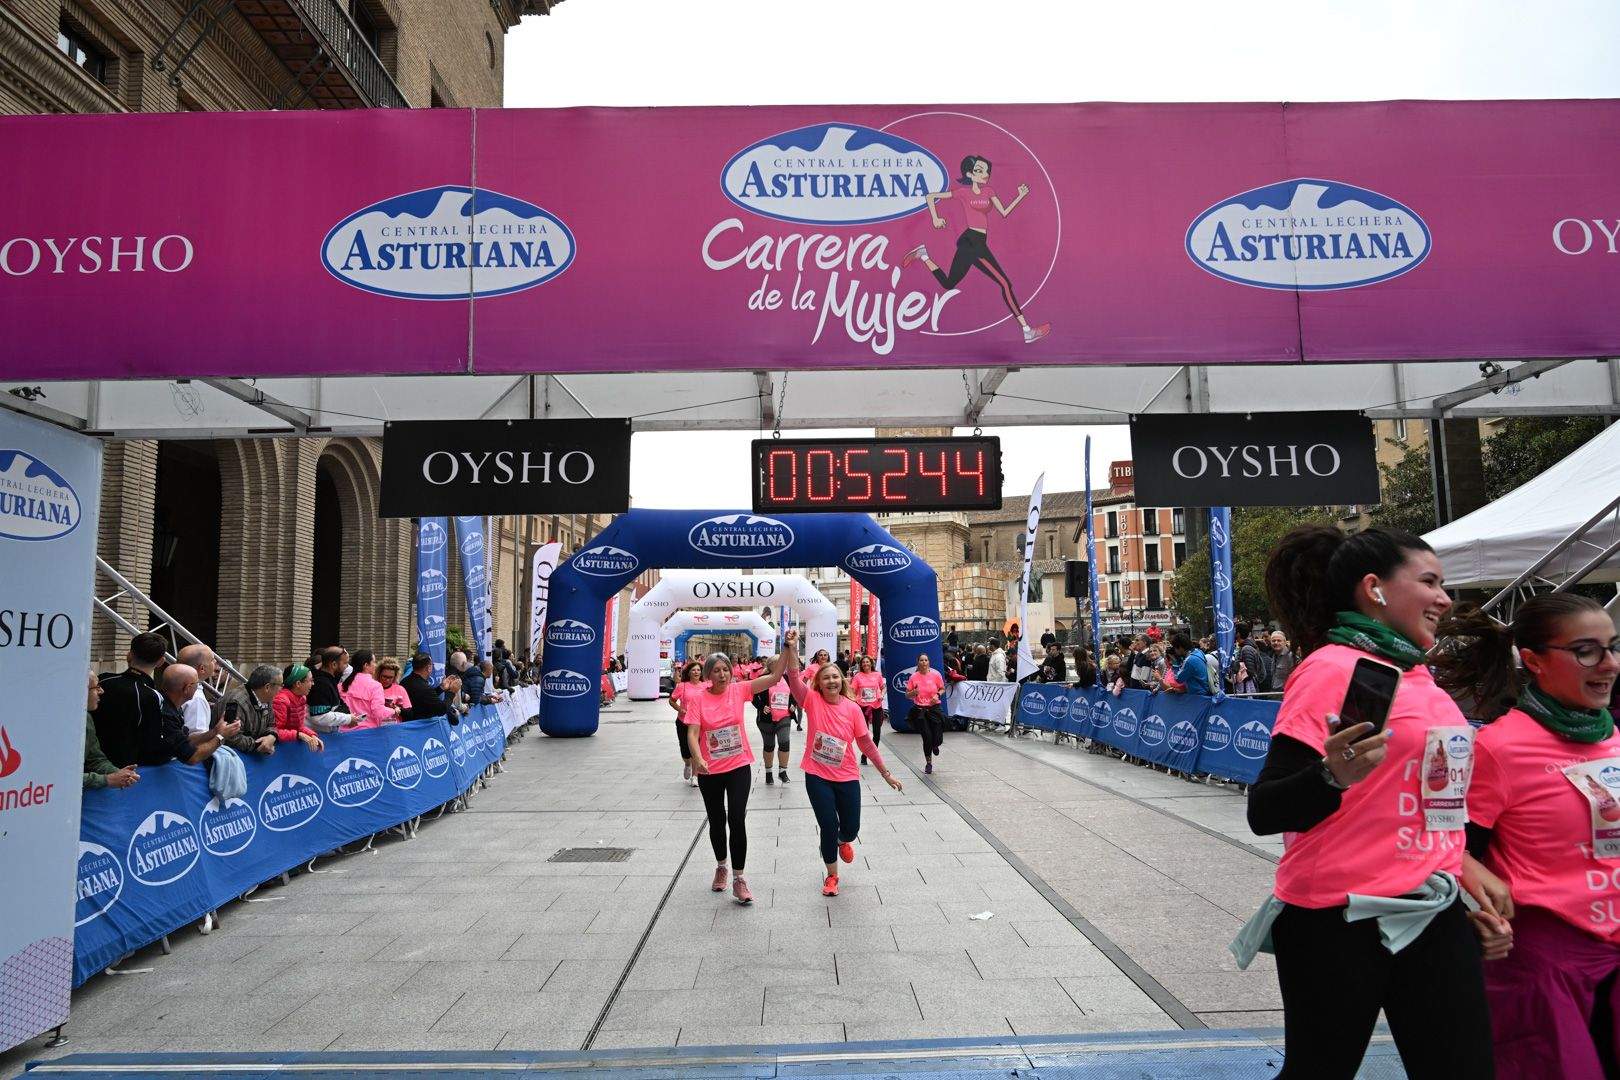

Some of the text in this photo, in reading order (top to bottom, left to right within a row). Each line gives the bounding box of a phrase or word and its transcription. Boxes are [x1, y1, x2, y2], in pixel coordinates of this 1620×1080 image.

[773, 158, 923, 168] CENTRAL LECHERA
[739, 160, 929, 198] ASTURIANA
[381, 223, 548, 236] CENTRAL LECHERA
[1242, 216, 1403, 228] CENTRAL LECHERA
[341, 230, 556, 271] ASTURIANA
[702, 218, 890, 271] Carrera
[1206, 221, 1414, 262] ASTURIANA
[0, 234, 194, 276] OYSHO
[748, 266, 961, 355] de la Mujer
[422, 451, 595, 485] OYSHO
[1172, 443, 1341, 479] OYSHO
[1113, 466, 1134, 478] TIB
[27, 484, 70, 501] LECHERA
[696, 527, 787, 547] ASTURIANA
[1120, 514, 1128, 556] HOTEL
[576, 557, 633, 570] ASTURIANA
[850, 556, 907, 568] ASTURIANA
[692, 580, 775, 599] OYSHO
[0, 609, 74, 650] SHO
[547, 629, 591, 641] ASTURIANA
[893, 626, 938, 638] ASTURIANA
[542, 679, 587, 691] ASTURIANA
[964, 684, 1004, 703] OYSHO
[390, 764, 421, 782] ASTURIANA
[332, 775, 381, 800] ASTURIANA
[264, 792, 320, 824] ASTURIANA
[1426, 815, 1455, 823] OYSHO
[142, 827, 191, 850] CENTRAL LECHERA
[204, 815, 254, 846] ASTURIANA
[80, 857, 111, 874] LECHERA
[135, 835, 198, 876] ASTURIANA
